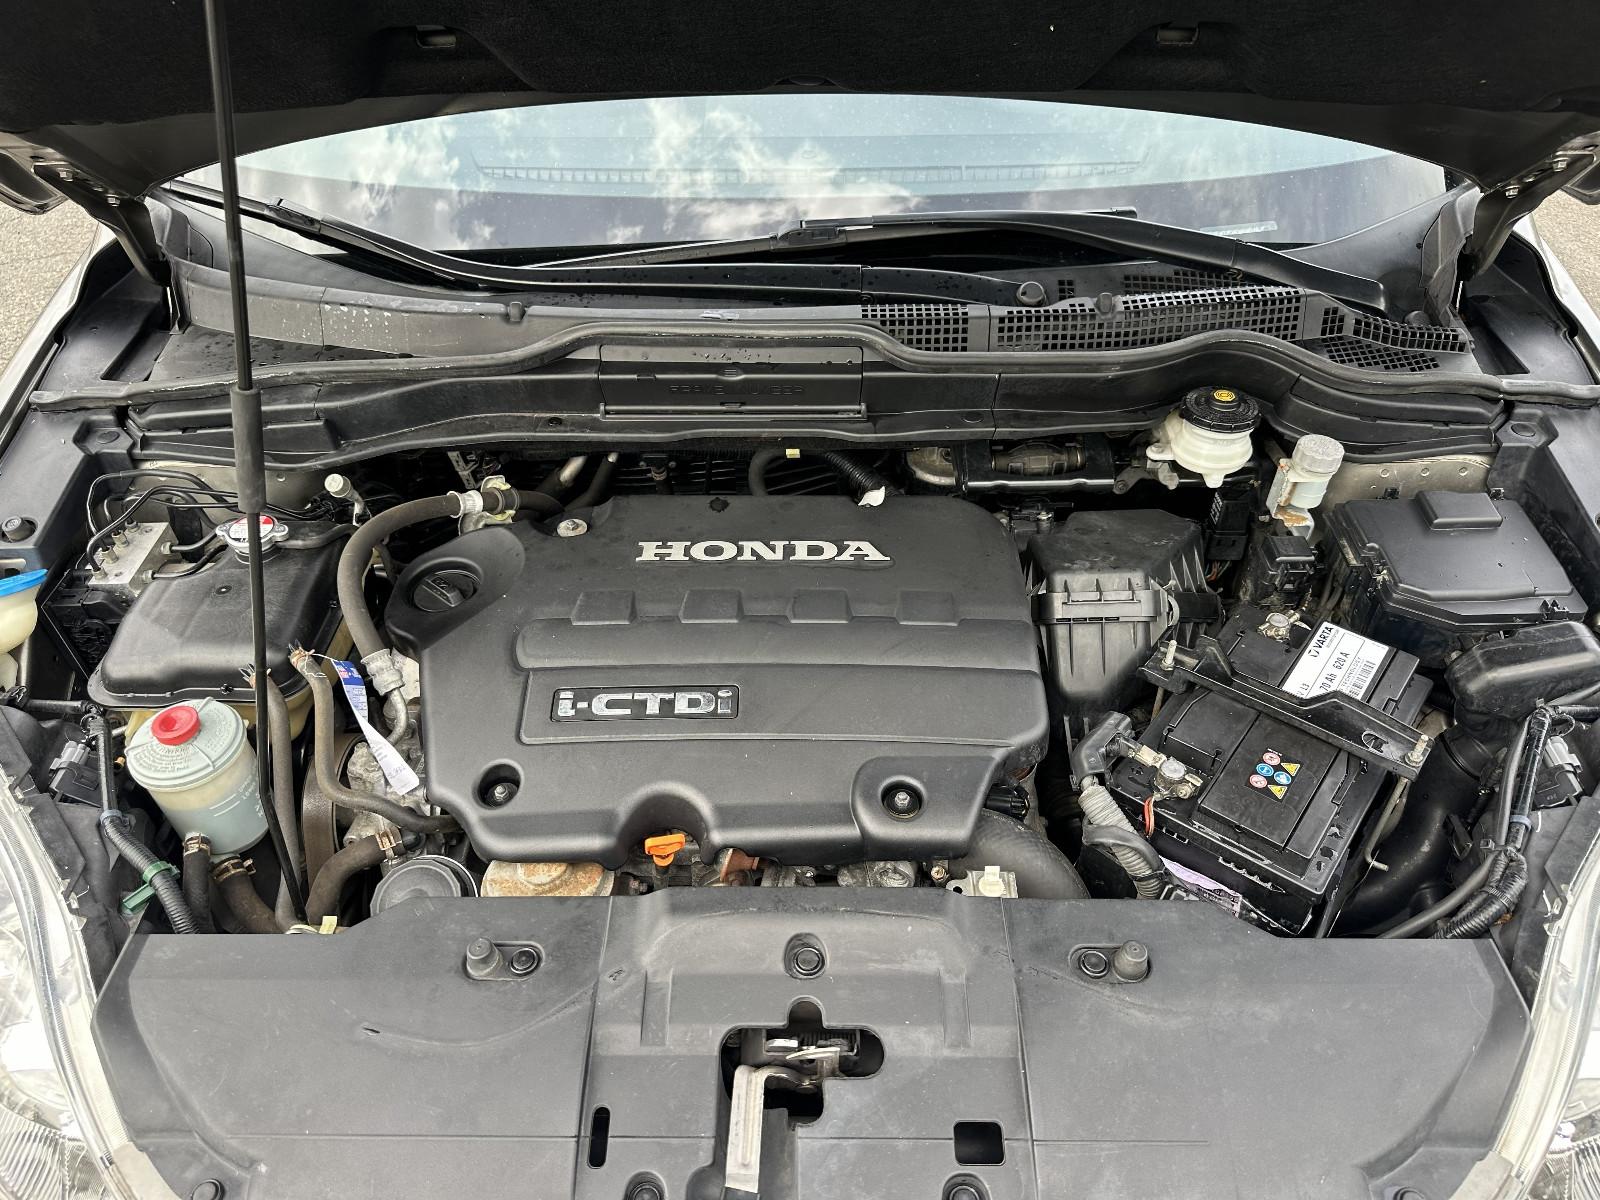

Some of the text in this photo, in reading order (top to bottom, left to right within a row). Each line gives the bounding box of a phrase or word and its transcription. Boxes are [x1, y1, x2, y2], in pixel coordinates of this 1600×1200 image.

[636, 540, 891, 562] HONDA
[1313, 627, 1334, 648] VARTA
[1319, 683, 1330, 692] 70
[1326, 673, 1338, 684] Ah
[1332, 657, 1346, 670] 620
[558, 689, 732, 717] i-CTDi
